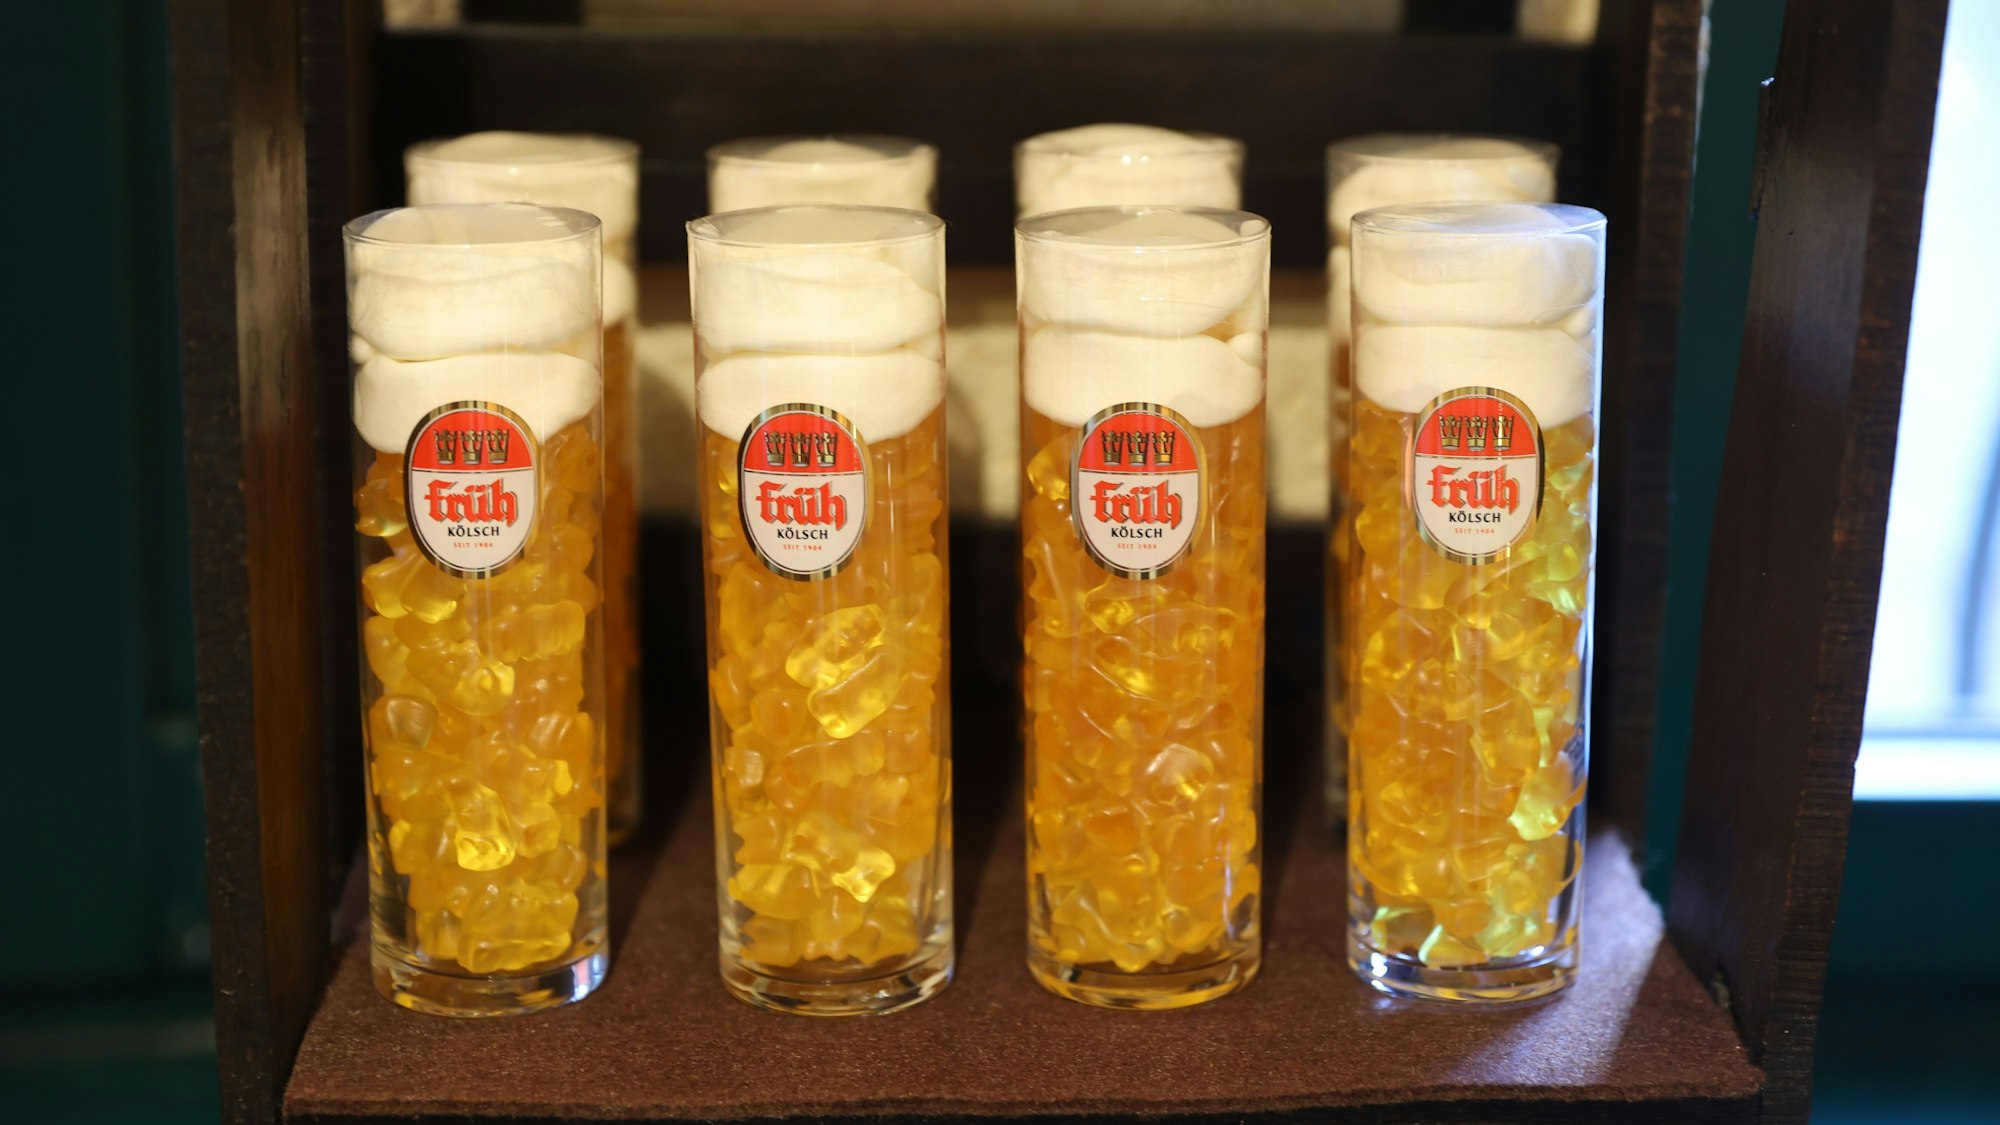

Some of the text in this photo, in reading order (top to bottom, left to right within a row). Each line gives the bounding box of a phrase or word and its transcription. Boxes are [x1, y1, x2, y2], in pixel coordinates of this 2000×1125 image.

[1449, 511, 1501, 523] KÖLSCH
[447, 525, 500, 537] KÖLSCH
[777, 527, 828, 540] KÖLSCH
[1111, 526, 1163, 538] KÖLSCH
